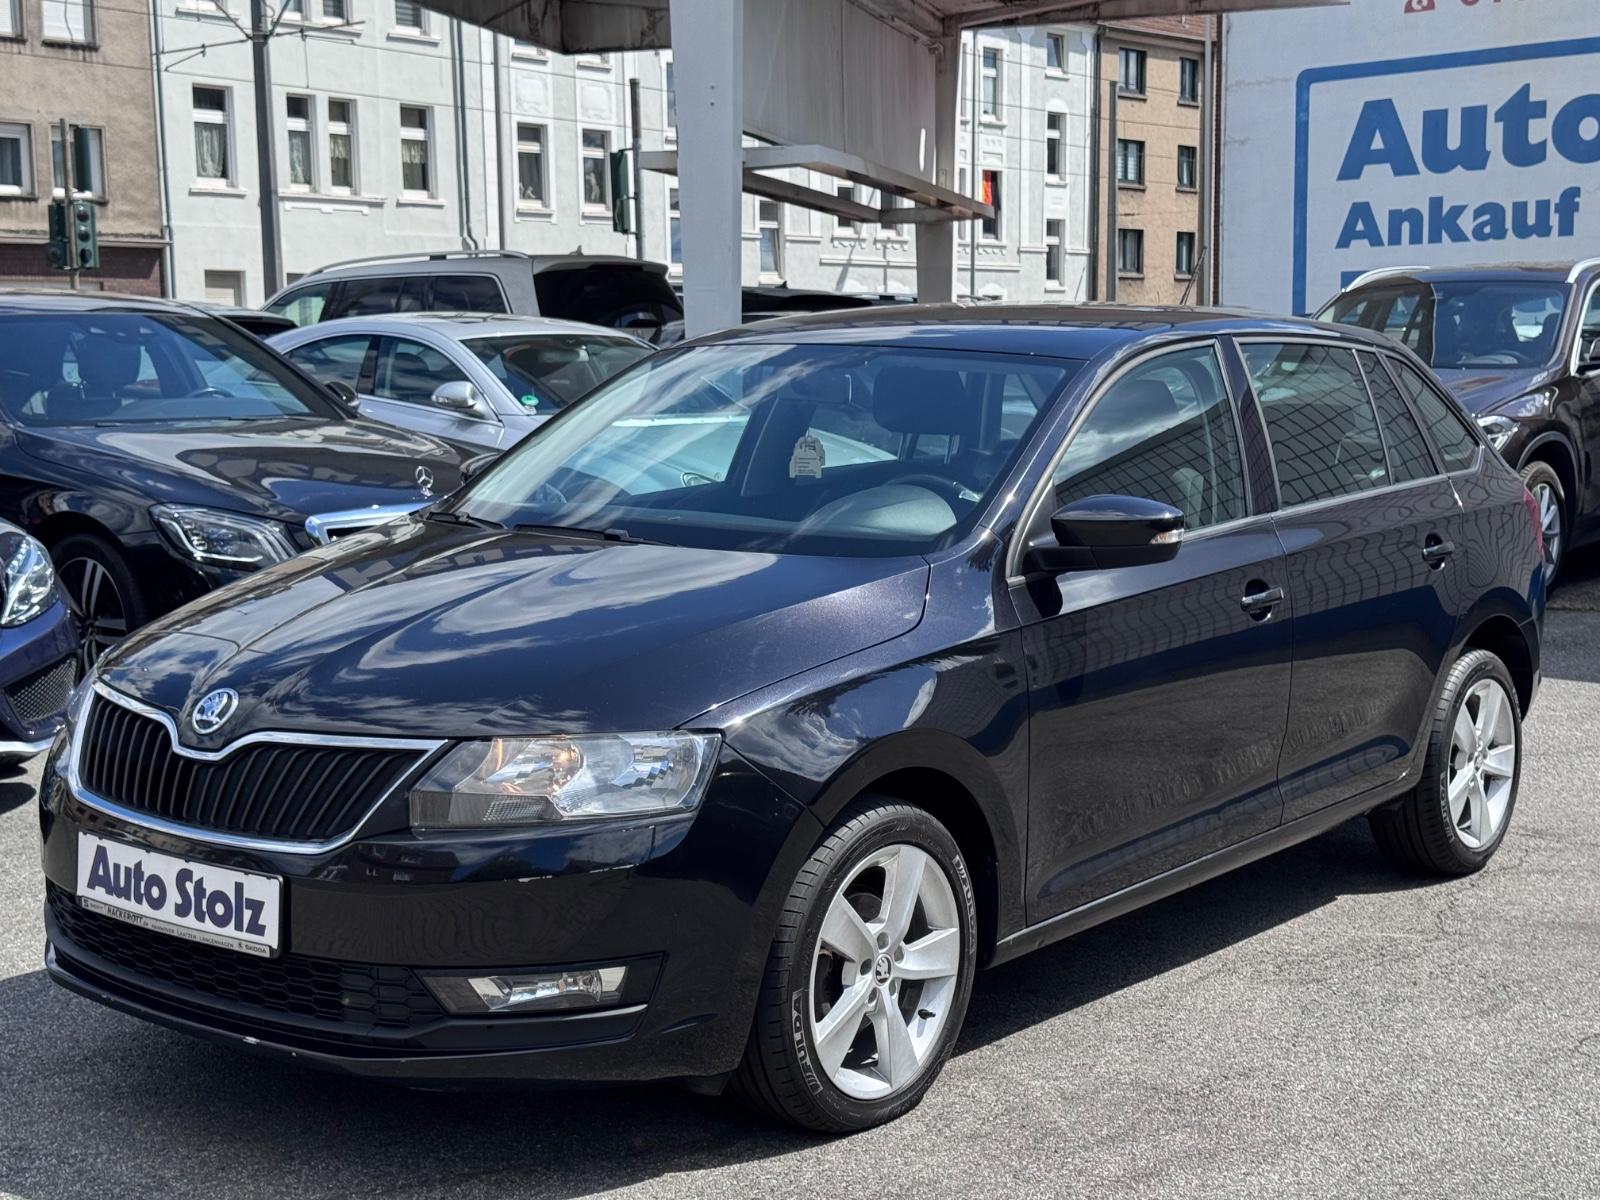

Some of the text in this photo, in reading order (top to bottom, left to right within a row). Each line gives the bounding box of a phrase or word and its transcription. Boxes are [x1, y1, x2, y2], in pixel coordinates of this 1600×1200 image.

[1336, 83, 1600, 181] Auto
[1335, 186, 1581, 249] Ankauf
[87, 844, 267, 937] Auto Stolz
